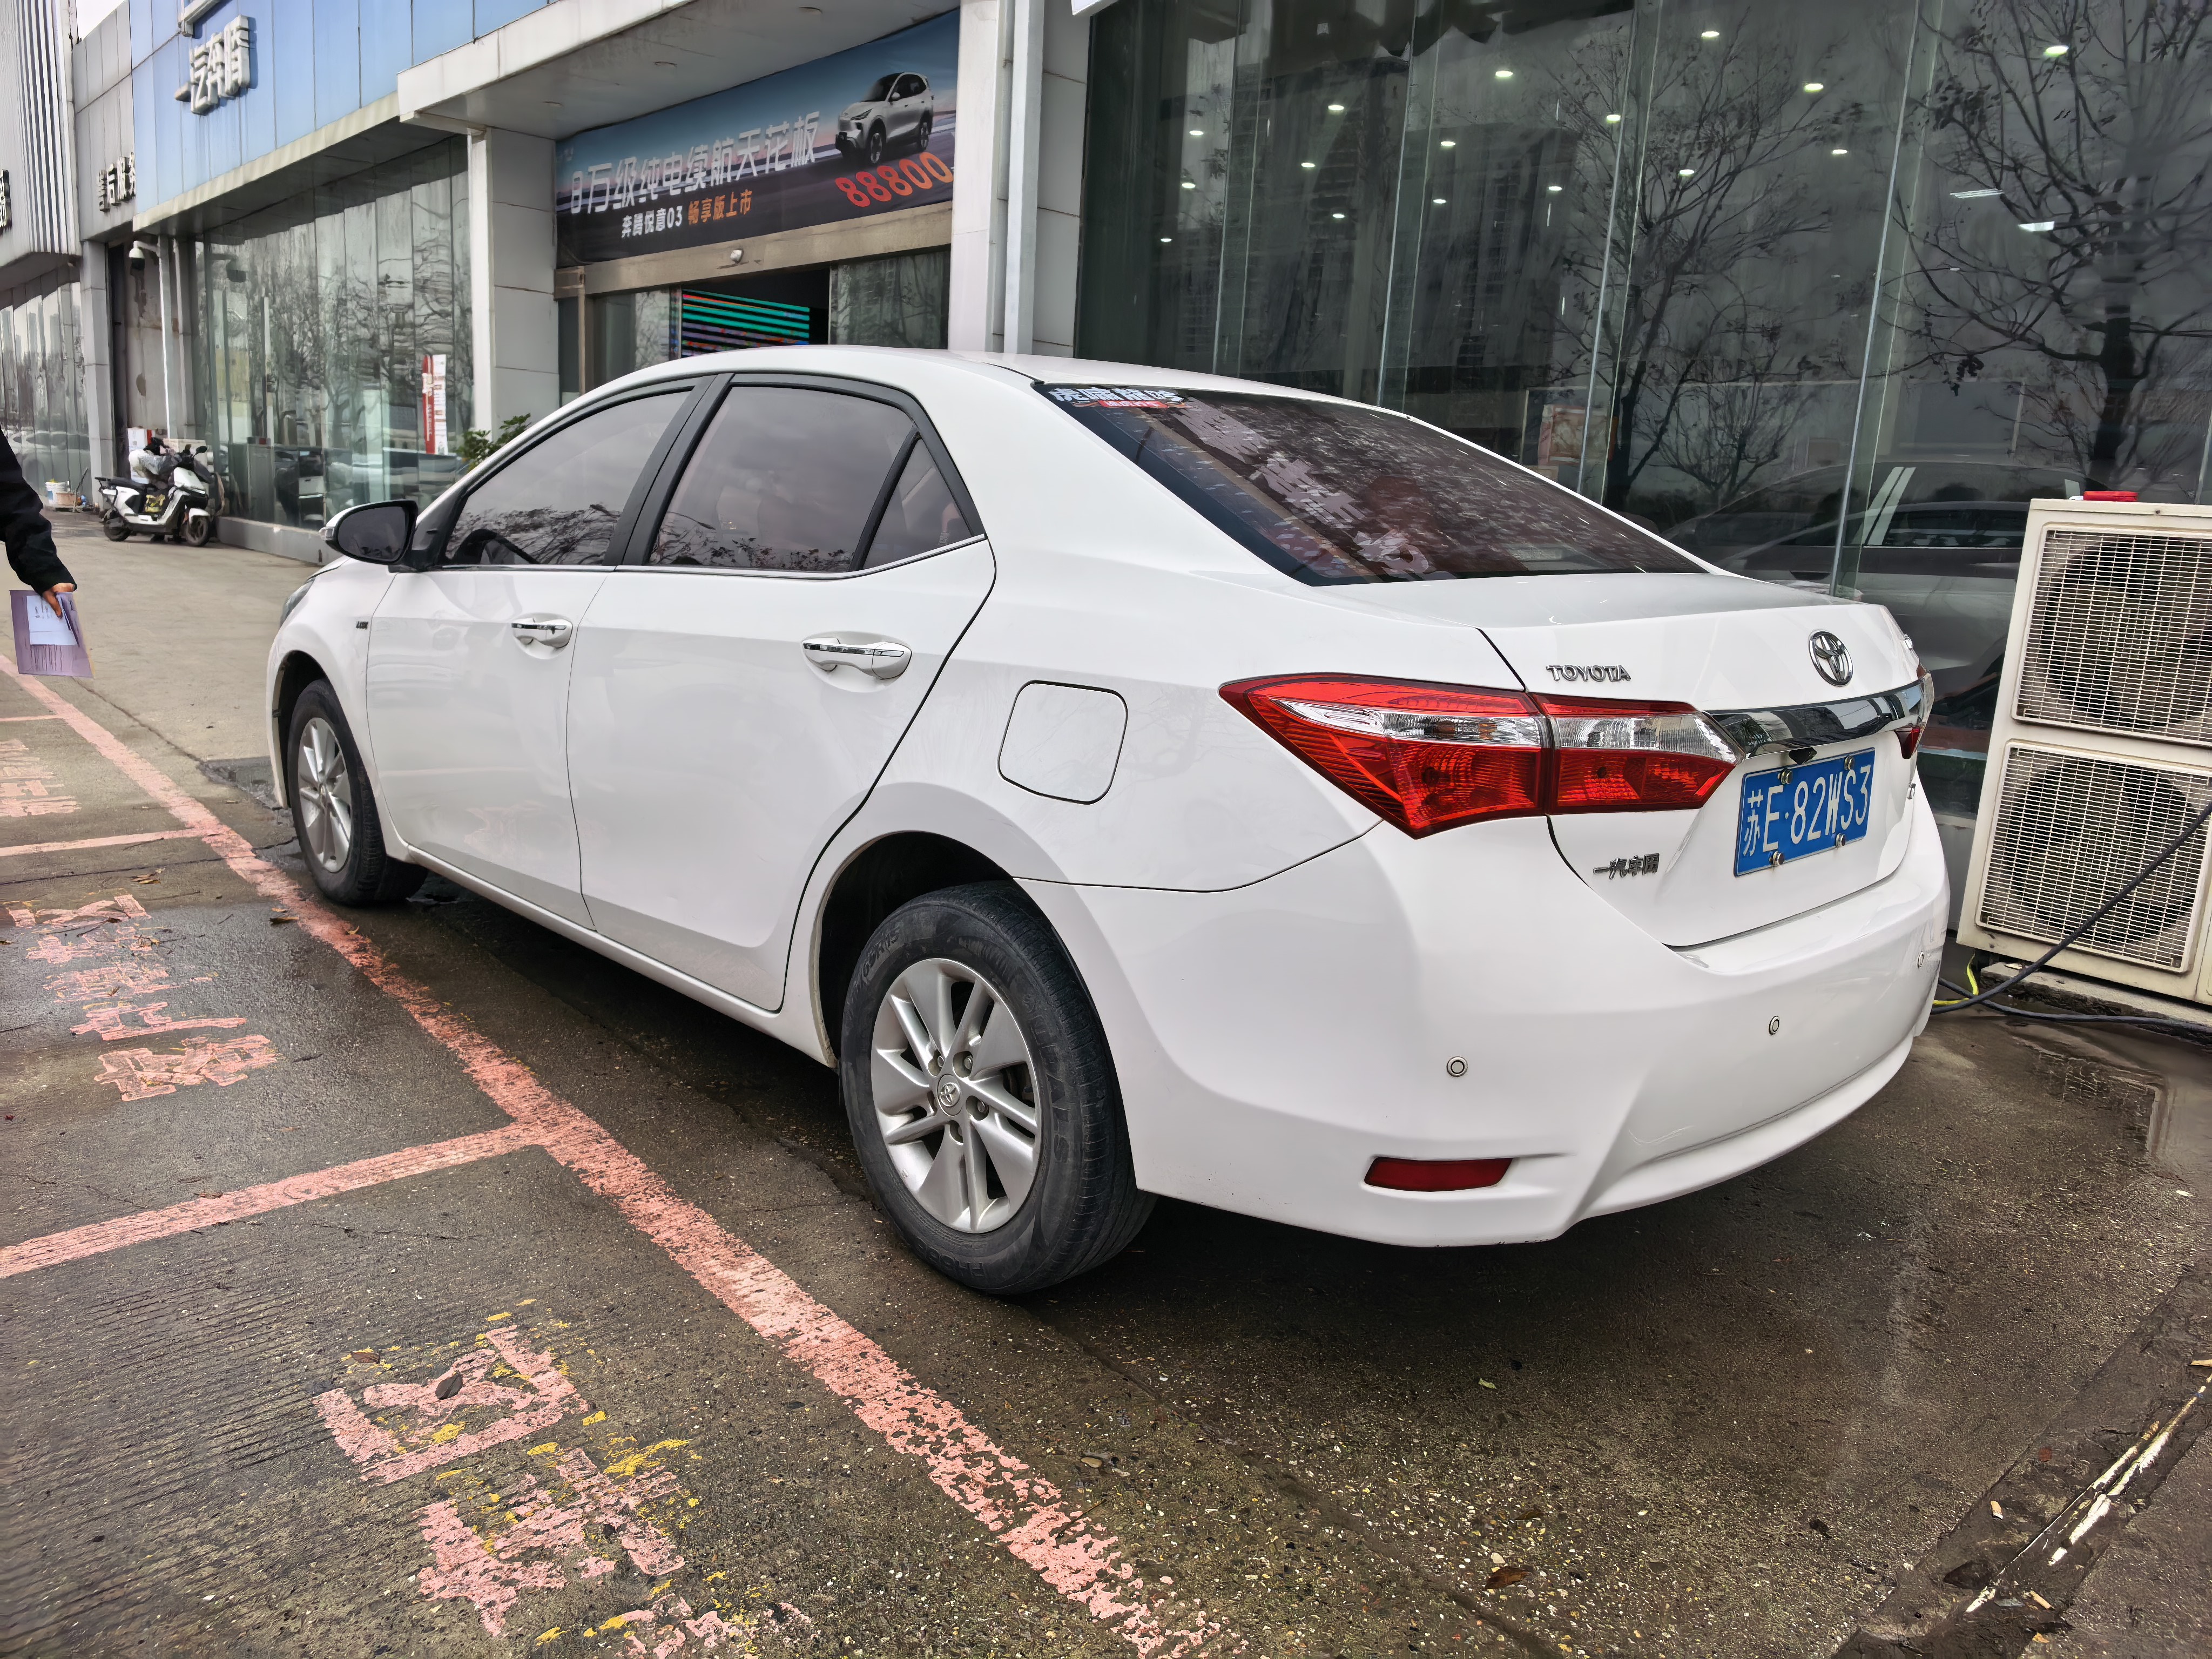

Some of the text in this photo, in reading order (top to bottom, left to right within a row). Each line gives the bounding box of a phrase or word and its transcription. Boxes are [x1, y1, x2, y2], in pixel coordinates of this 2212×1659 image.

[570, 111, 820, 214] 8万级纯电续航天花板
[835, 152, 954, 207] 88800
[687, 188, 752, 225] 畅享版上市
[1546, 664, 1631, 682] TOYOTA
